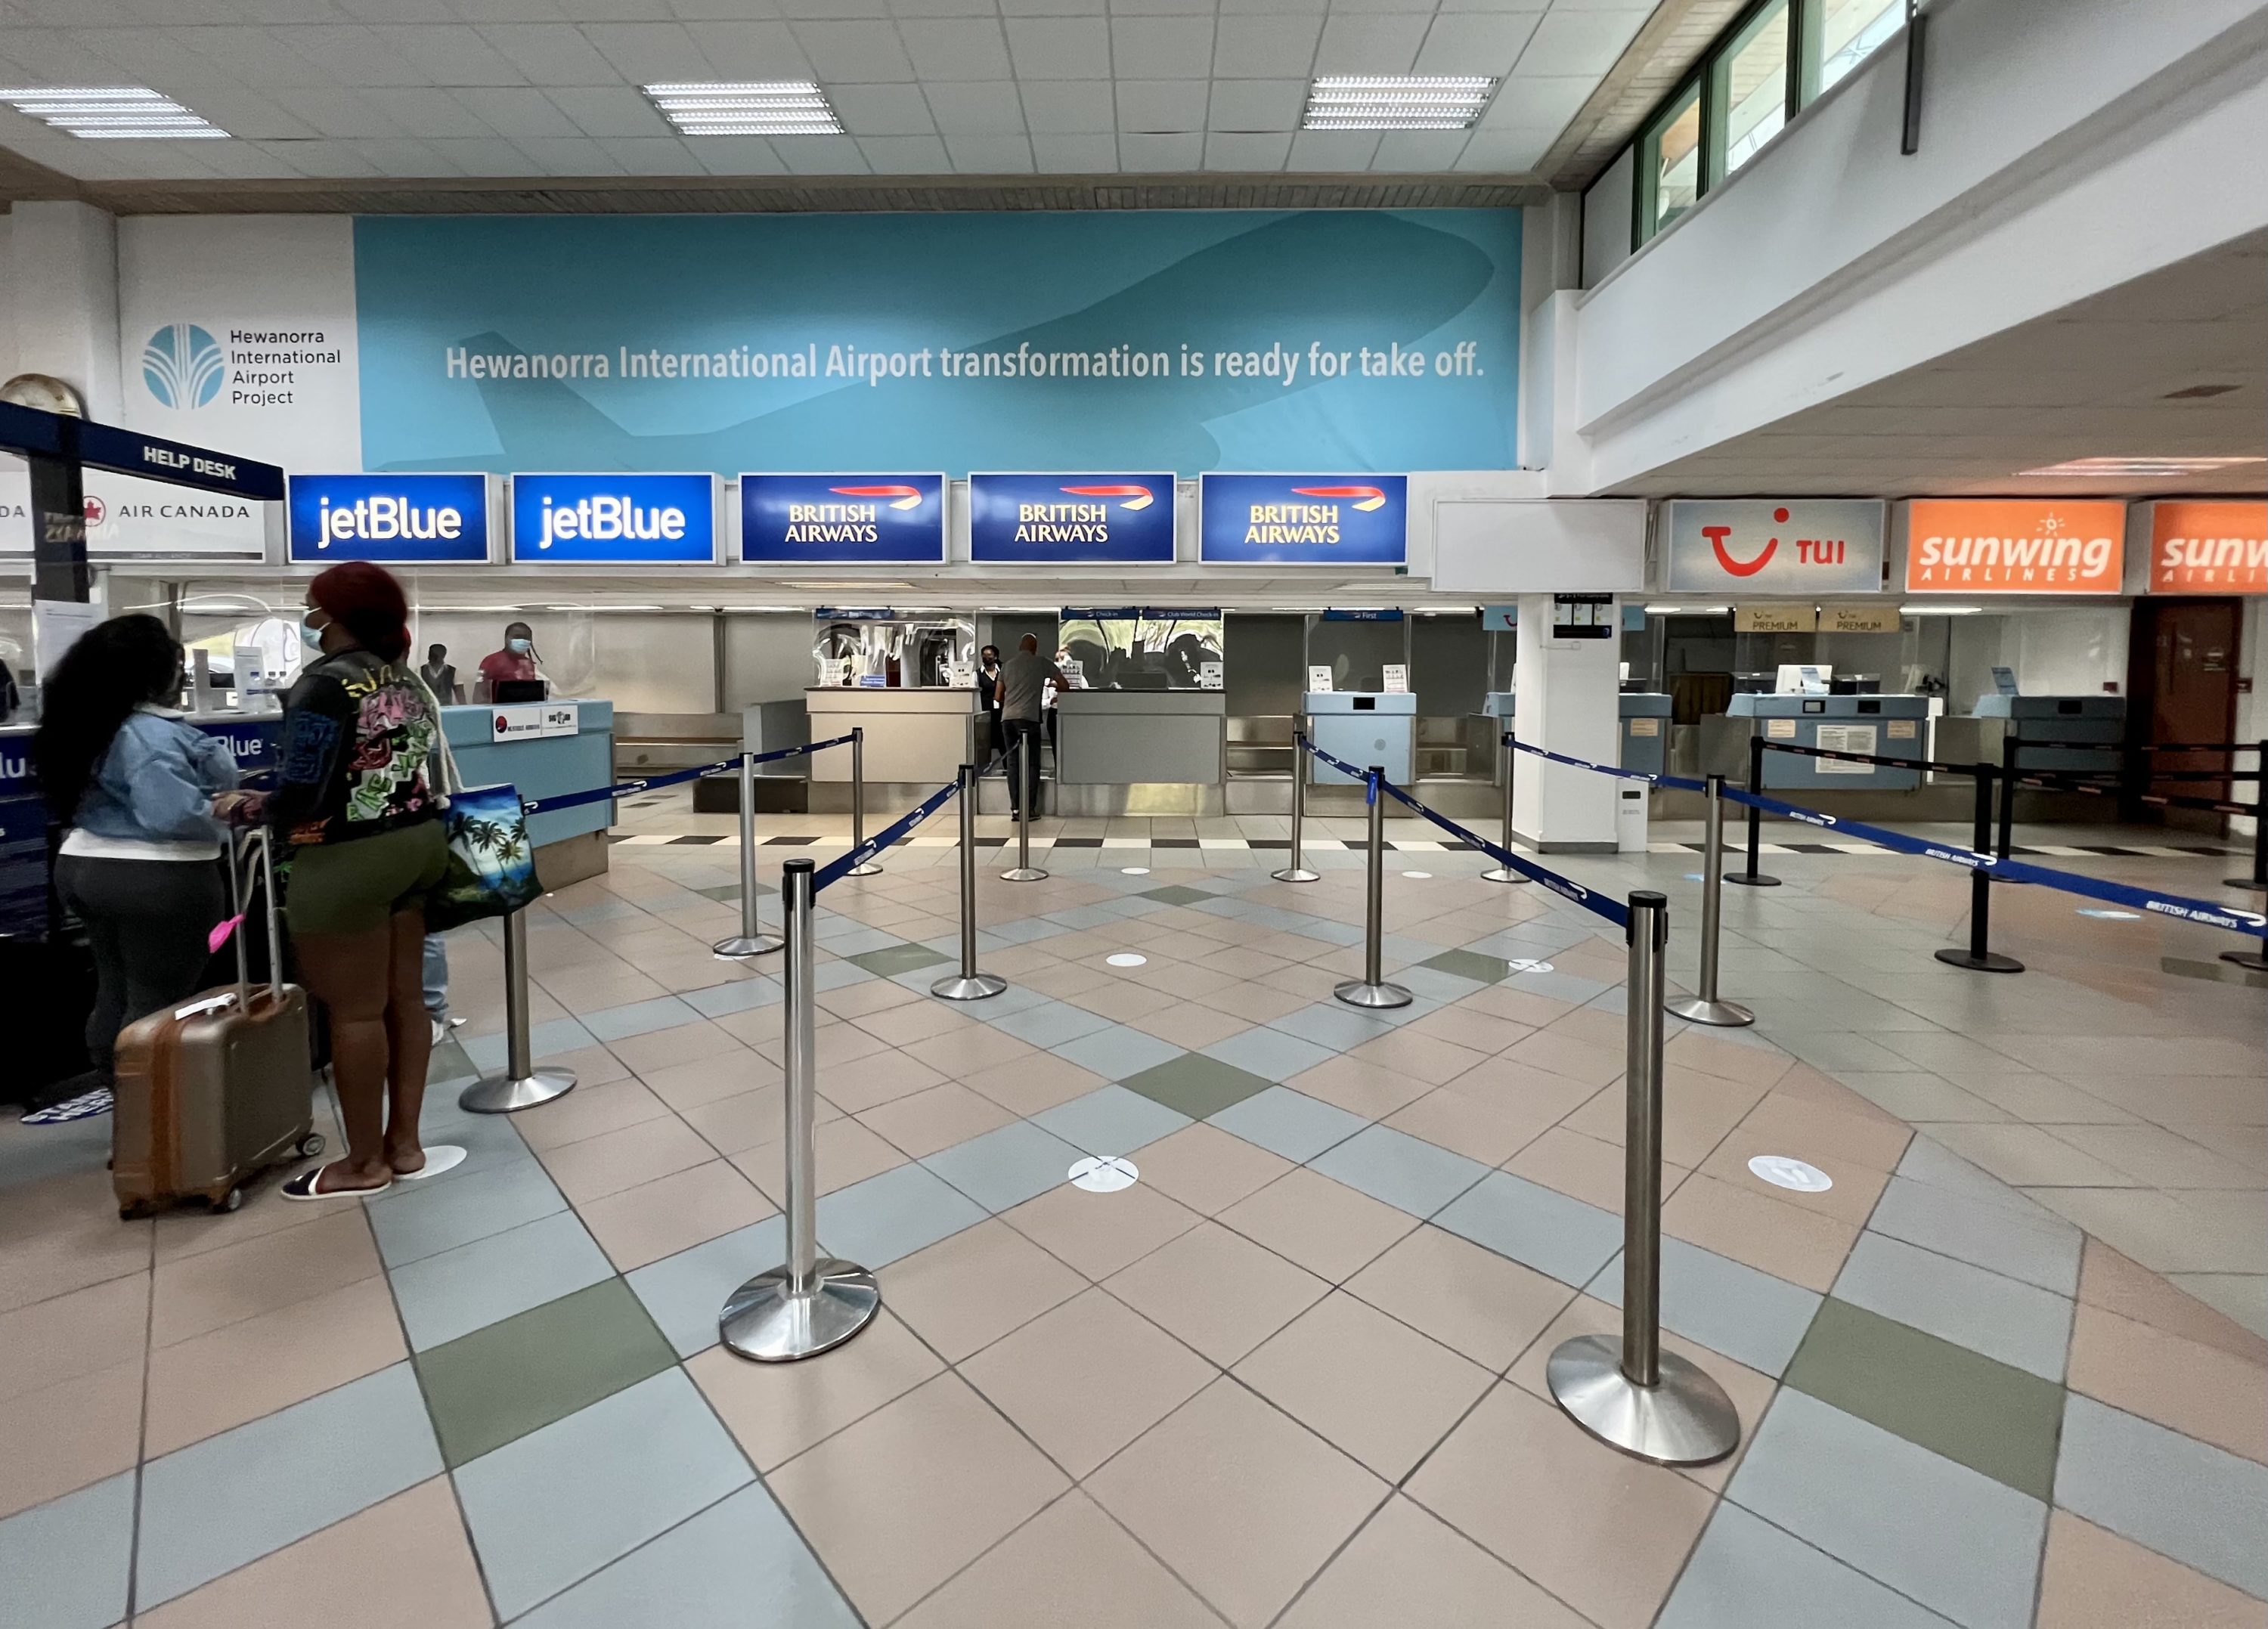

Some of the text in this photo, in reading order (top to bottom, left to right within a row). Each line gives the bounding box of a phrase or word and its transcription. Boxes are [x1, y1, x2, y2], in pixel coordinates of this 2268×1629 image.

[230, 330, 324, 343] Hewanorra
[231, 349, 341, 364] International
[446, 341, 1483, 386] Hewanorra International Airport transformation is ready for take off.
[232, 370, 294, 386] Airport
[232, 390, 294, 406] Project
[144, 446, 237, 480] HELP DESK
[118, 505, 249, 518] AIR CANADA
[789, 504, 875, 523] BRITISH
[1019, 504, 1106, 523] BRITISH
[1250, 505, 1338, 524] BRITISH
[318, 495, 462, 550] jetBlue
[539, 495, 686, 550] jetBlue
[785, 525, 878, 543] AIRWAYS
[1015, 525, 1108, 543] AIRWAYS
[1244, 525, 1340, 544] AIRWAYS
[1796, 540, 1845, 564] TUI
[1919, 535, 2112, 578] sunwing
[1921, 568, 2077, 581] AIRLINES
[1752, 621, 1798, 630] PREMIUM
[1837, 621, 1882, 630] PREMIUM
[2146, 900, 2238, 928] BRITISH AIRWAYS
